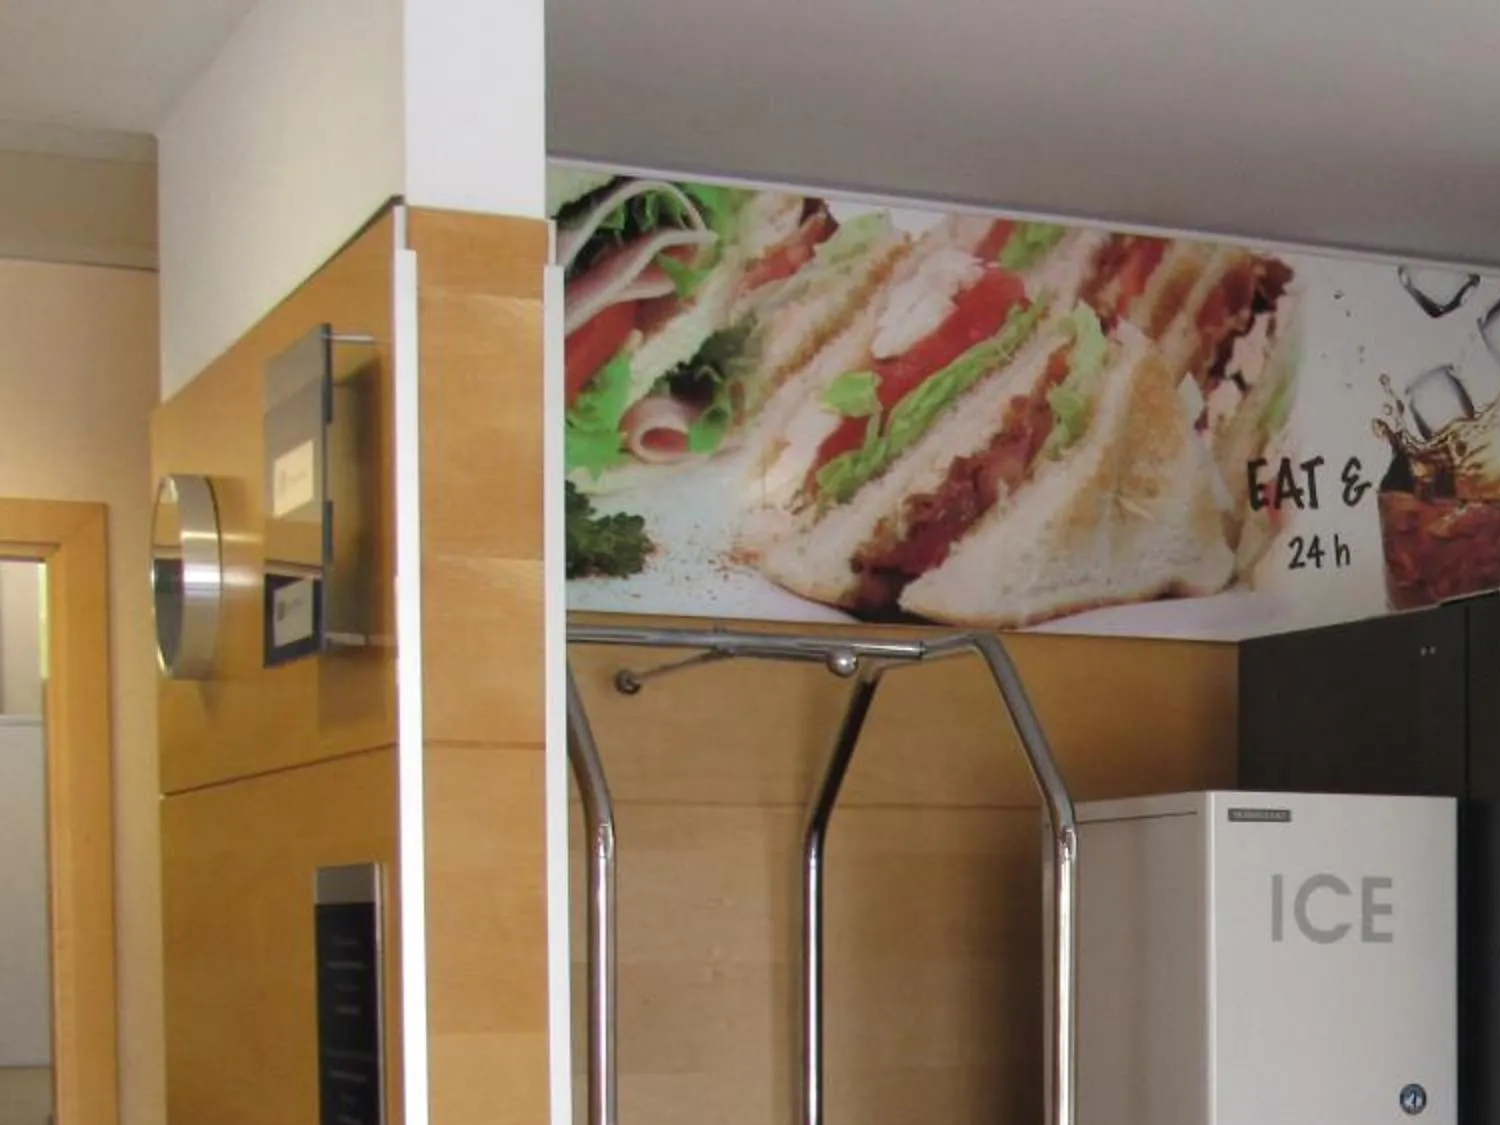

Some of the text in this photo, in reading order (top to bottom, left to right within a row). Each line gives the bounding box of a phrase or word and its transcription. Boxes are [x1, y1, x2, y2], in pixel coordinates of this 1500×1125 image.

[1247, 456, 1324, 511] EAT
[1341, 456, 1372, 507] &
[1288, 533, 1351, 570] 24 h
[1271, 873, 1393, 944] ICE
